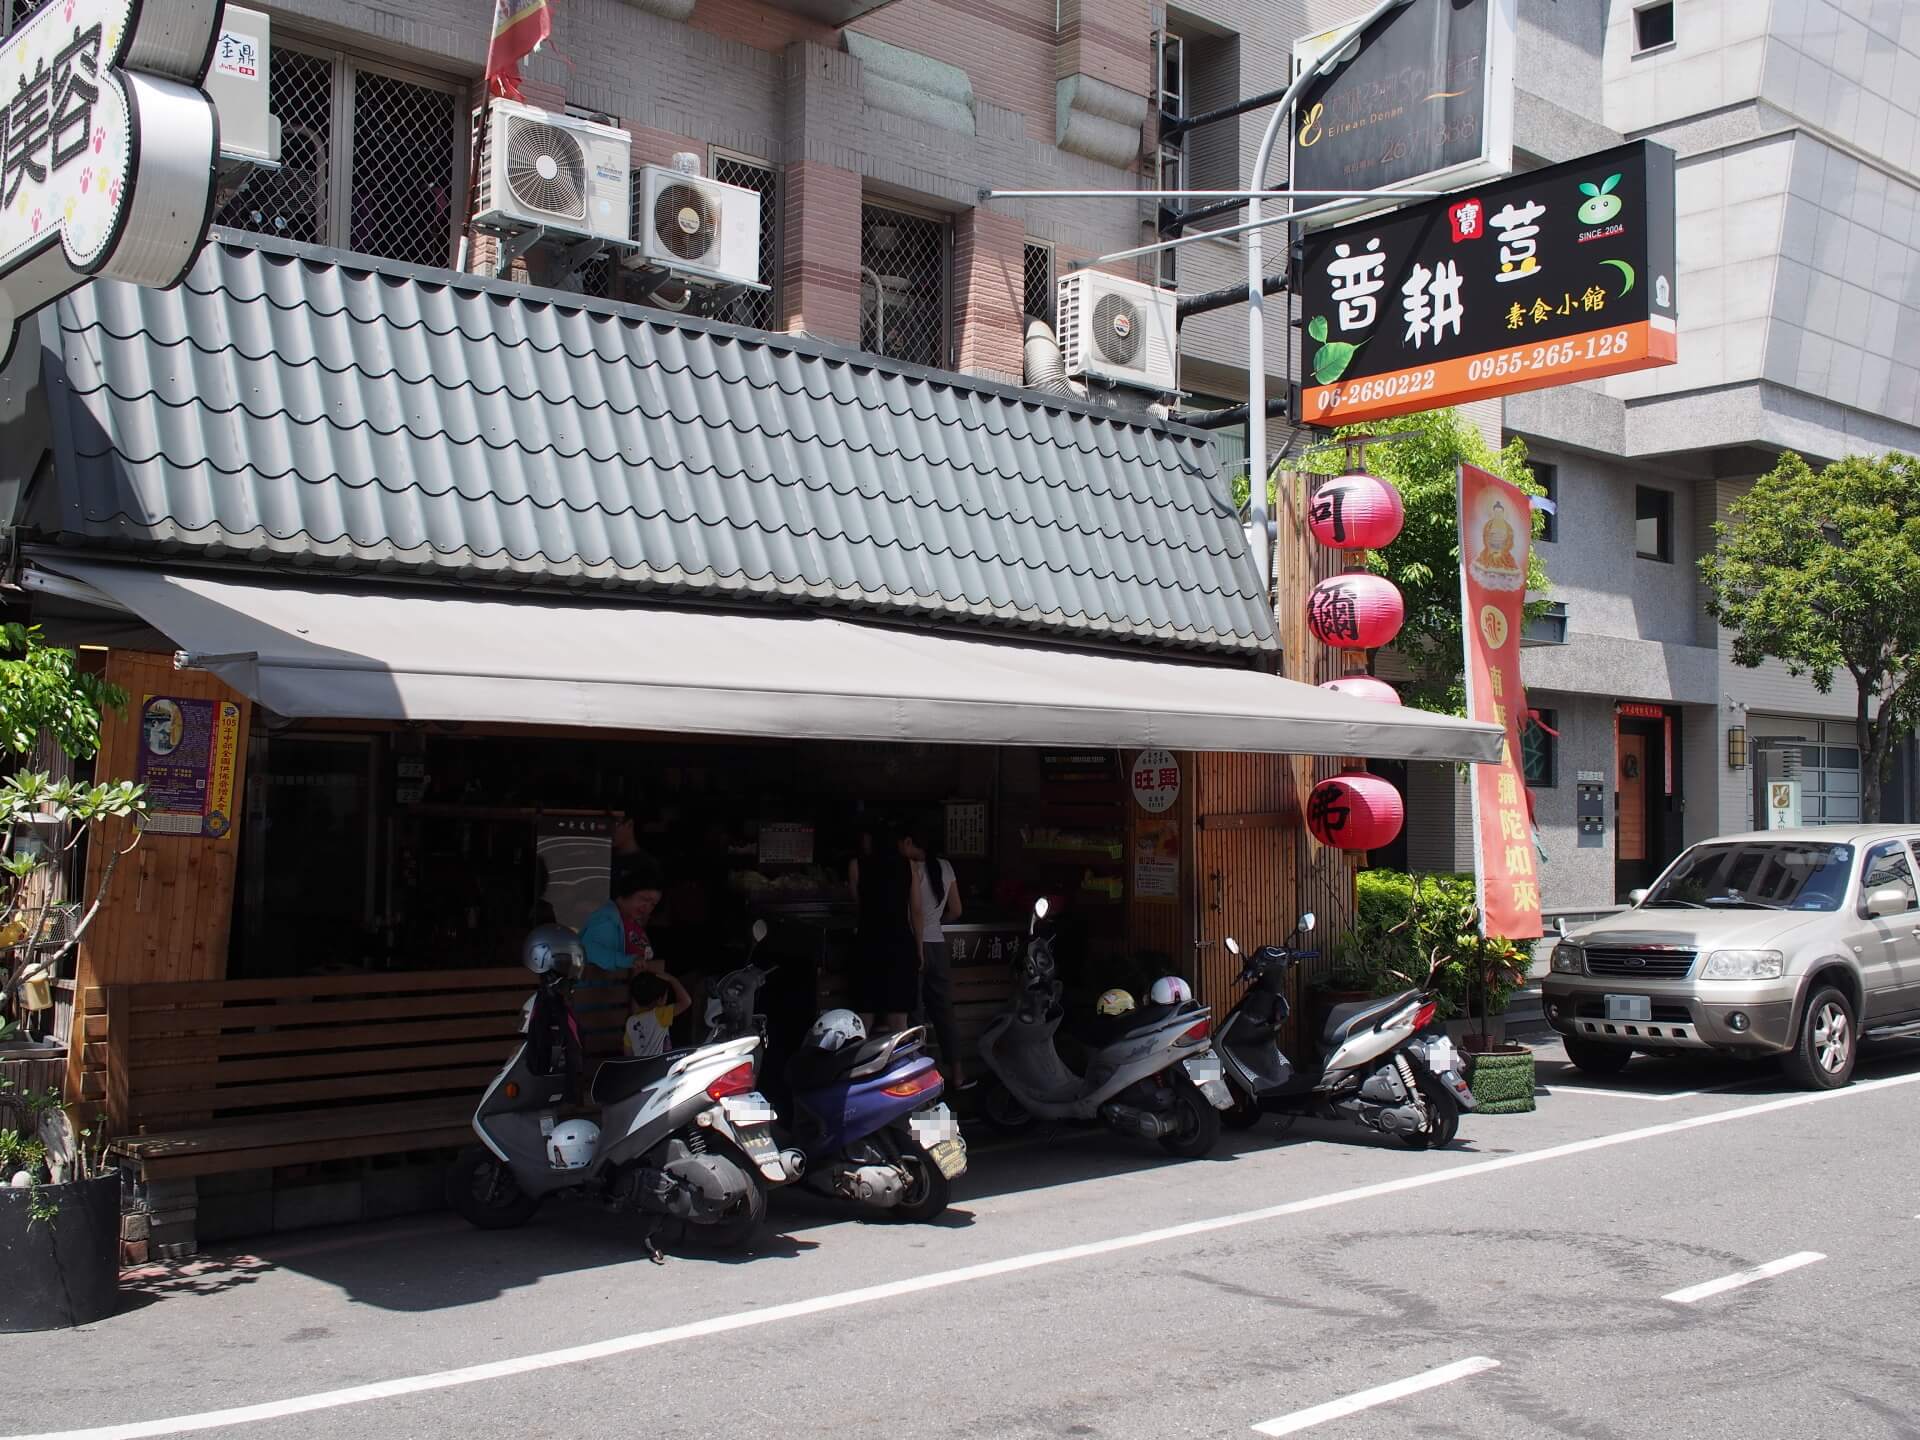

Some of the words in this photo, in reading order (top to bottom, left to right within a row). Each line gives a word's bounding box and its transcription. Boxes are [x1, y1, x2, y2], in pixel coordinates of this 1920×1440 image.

[219, 34, 256, 67] 金鼎
[0, 22, 102, 209] 美容
[1578, 229, 1602, 241] SINCE
[1605, 223, 1623, 234] 2004
[1505, 285, 1606, 329] 素食小館
[1318, 369, 1435, 410] 06-2680222
[1468, 331, 1628, 381] 0955-265-128
